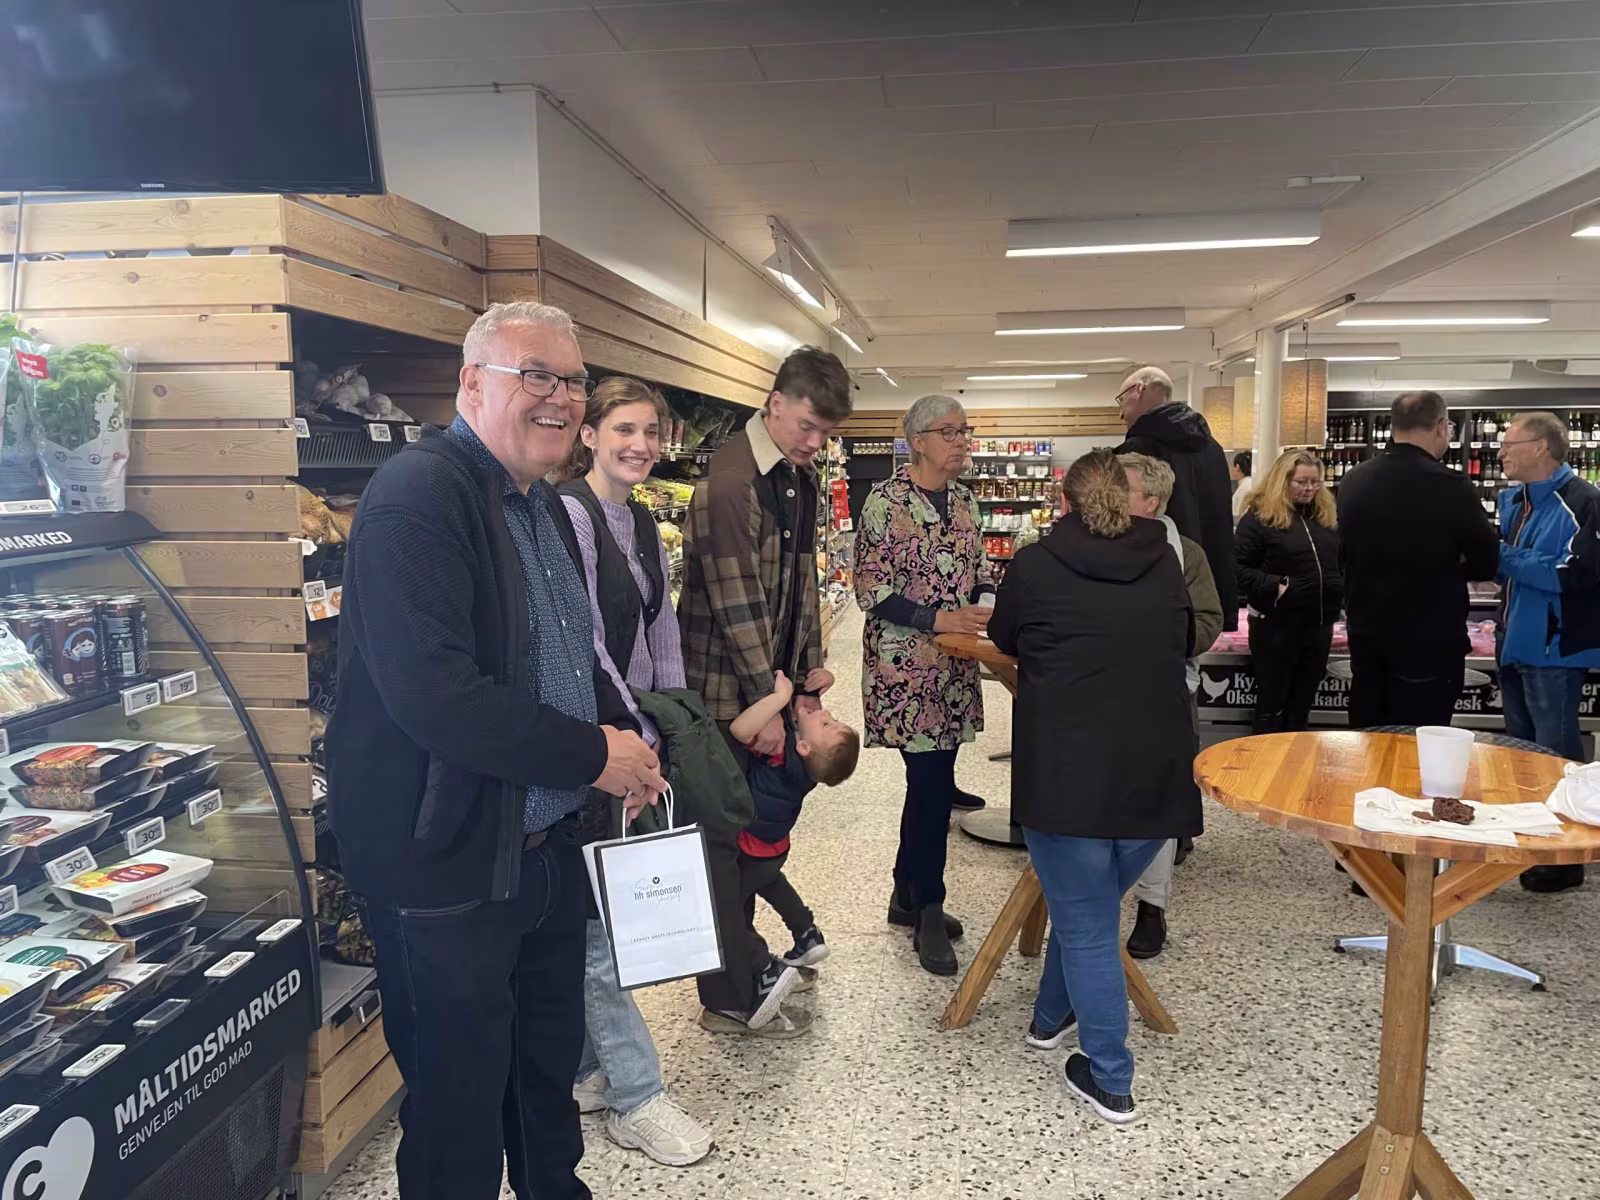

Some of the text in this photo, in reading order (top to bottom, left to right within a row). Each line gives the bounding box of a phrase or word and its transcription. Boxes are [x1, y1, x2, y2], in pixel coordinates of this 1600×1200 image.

[1234, 672, 1259, 693] Ky
[634, 891, 644, 901] hh
[646, 884, 682, 899] simonsen
[114, 968, 301, 1135] MÅLTIDSMARKED
[118, 1040, 252, 1161] GENVEJEN TIL GOD MAD
